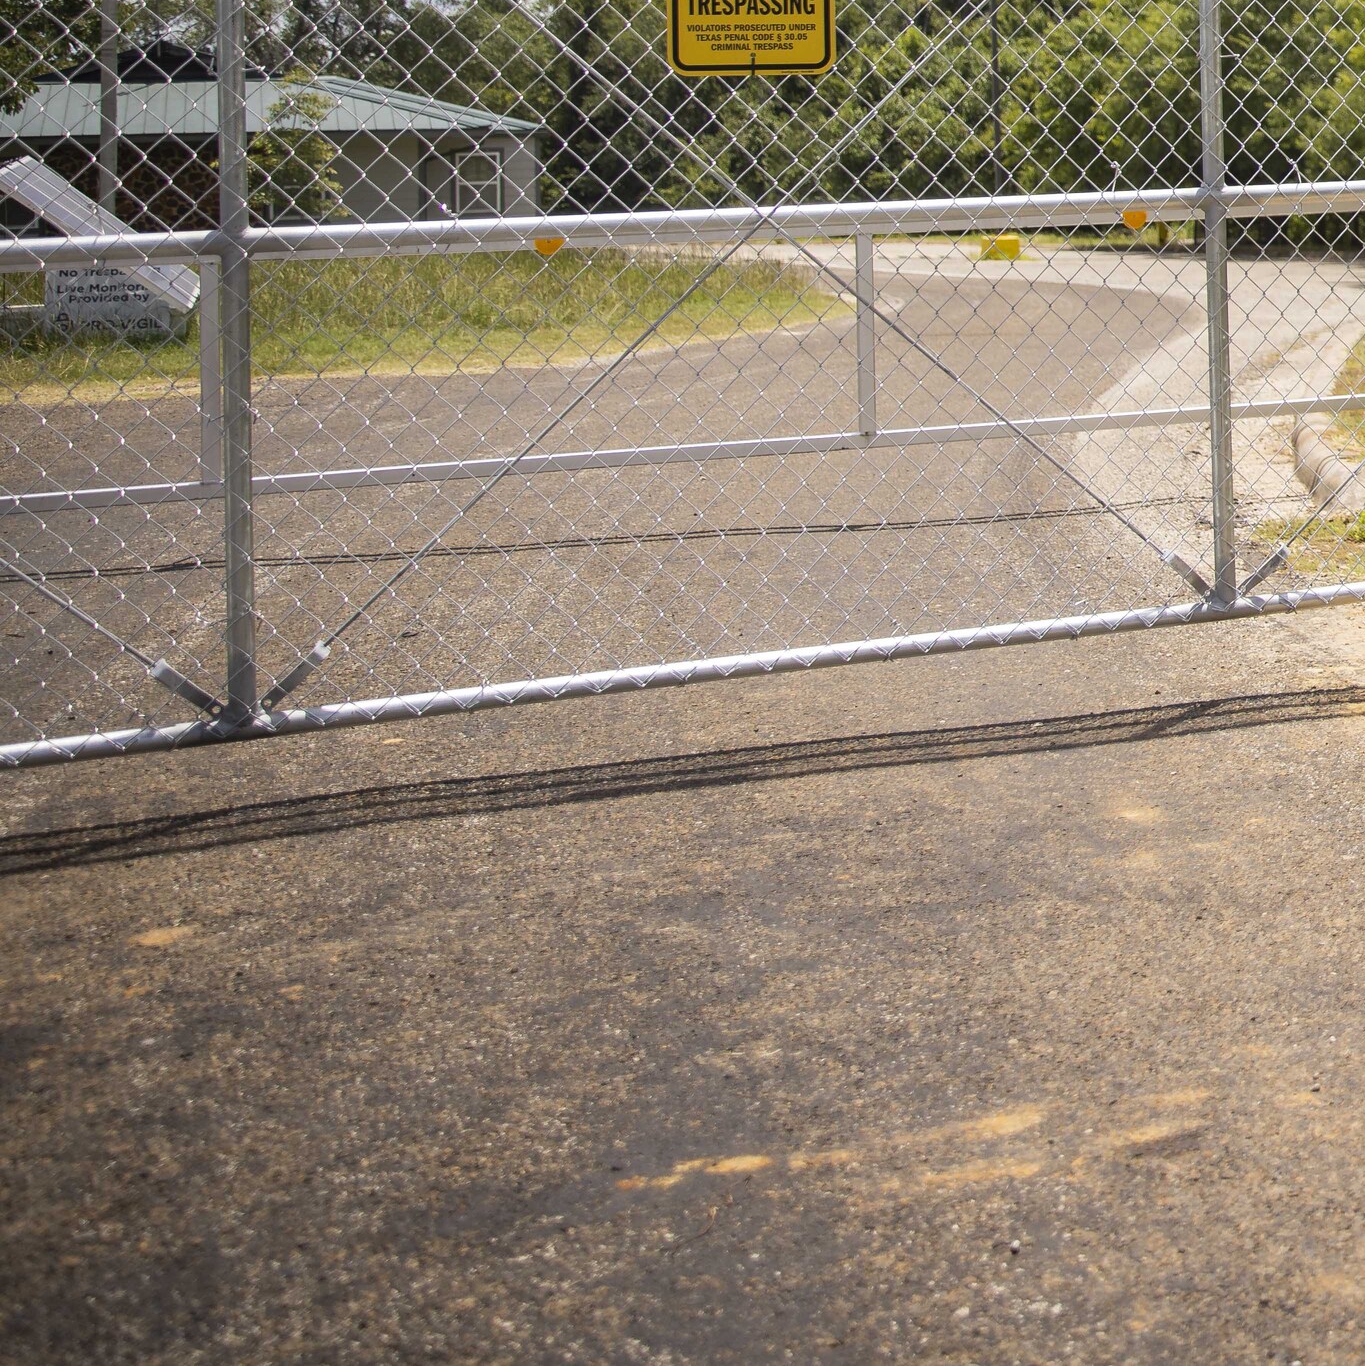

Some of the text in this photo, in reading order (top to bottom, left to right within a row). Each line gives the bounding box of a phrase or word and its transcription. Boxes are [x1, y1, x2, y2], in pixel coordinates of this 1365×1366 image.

[687, 23, 816, 32] VIOLATORS PROSECUTED UNDER
[696, 33, 808, 42] TEXAS PENAL CODE § 30.05
[711, 42, 794, 51] CRIMINAL TRESPASS
[59, 269, 78, 277] No
[57, 284, 84, 294] Live
[69, 291, 149, 303] Provided by
